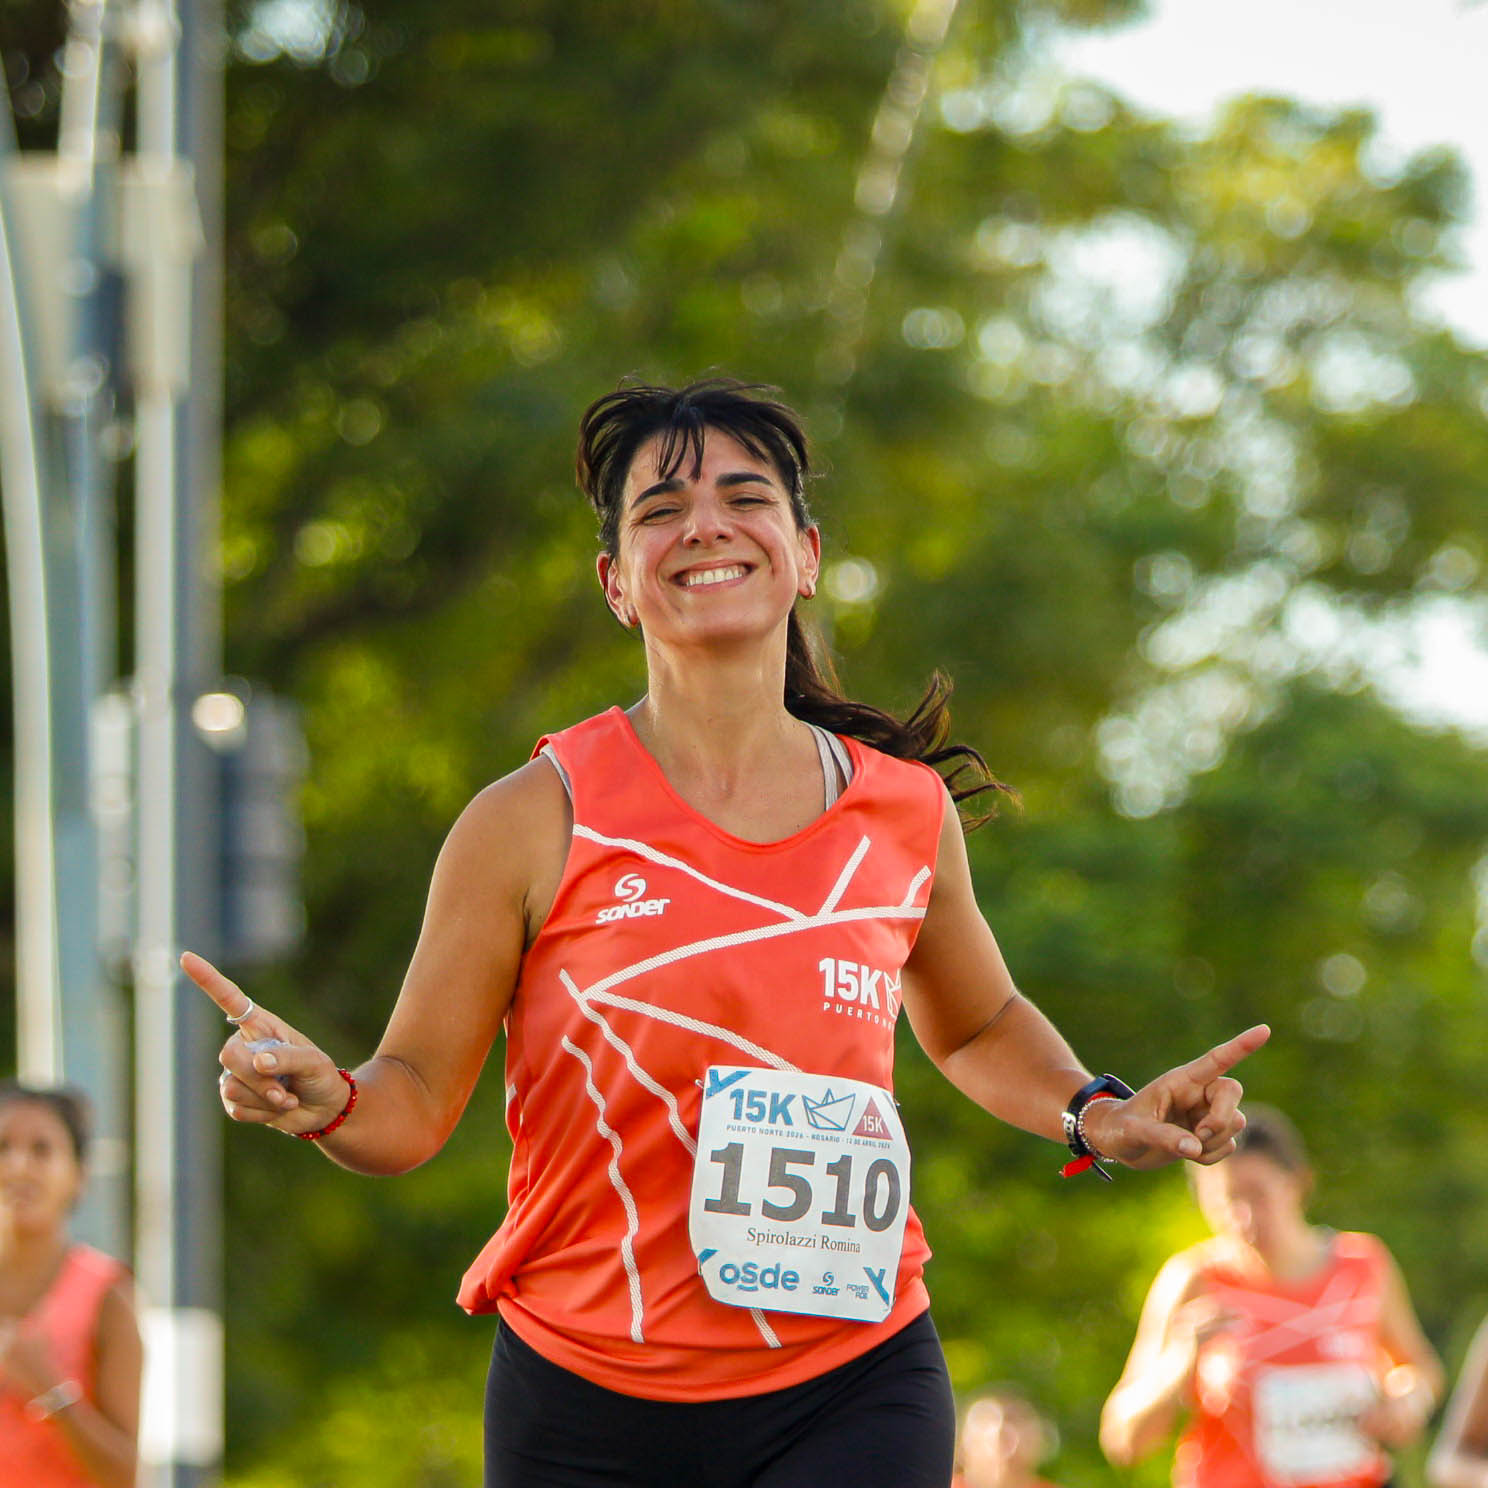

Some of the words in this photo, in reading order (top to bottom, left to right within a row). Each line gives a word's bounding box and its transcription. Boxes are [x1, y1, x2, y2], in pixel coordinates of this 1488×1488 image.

[818, 957, 882, 1010] 15K
[823, 1002, 880, 1024] PUERTO
[729, 1088, 796, 1126] 15K
[726, 1124, 757, 1134] PUERTO
[759, 1127, 784, 1137] NORTE
[811, 1133, 840, 1144] ROSARIO
[863, 1115, 884, 1134] 15K
[703, 1141, 901, 1233] 1510
[746, 1227, 817, 1249] Spirolazzi
[820, 1235, 861, 1253] Romina
